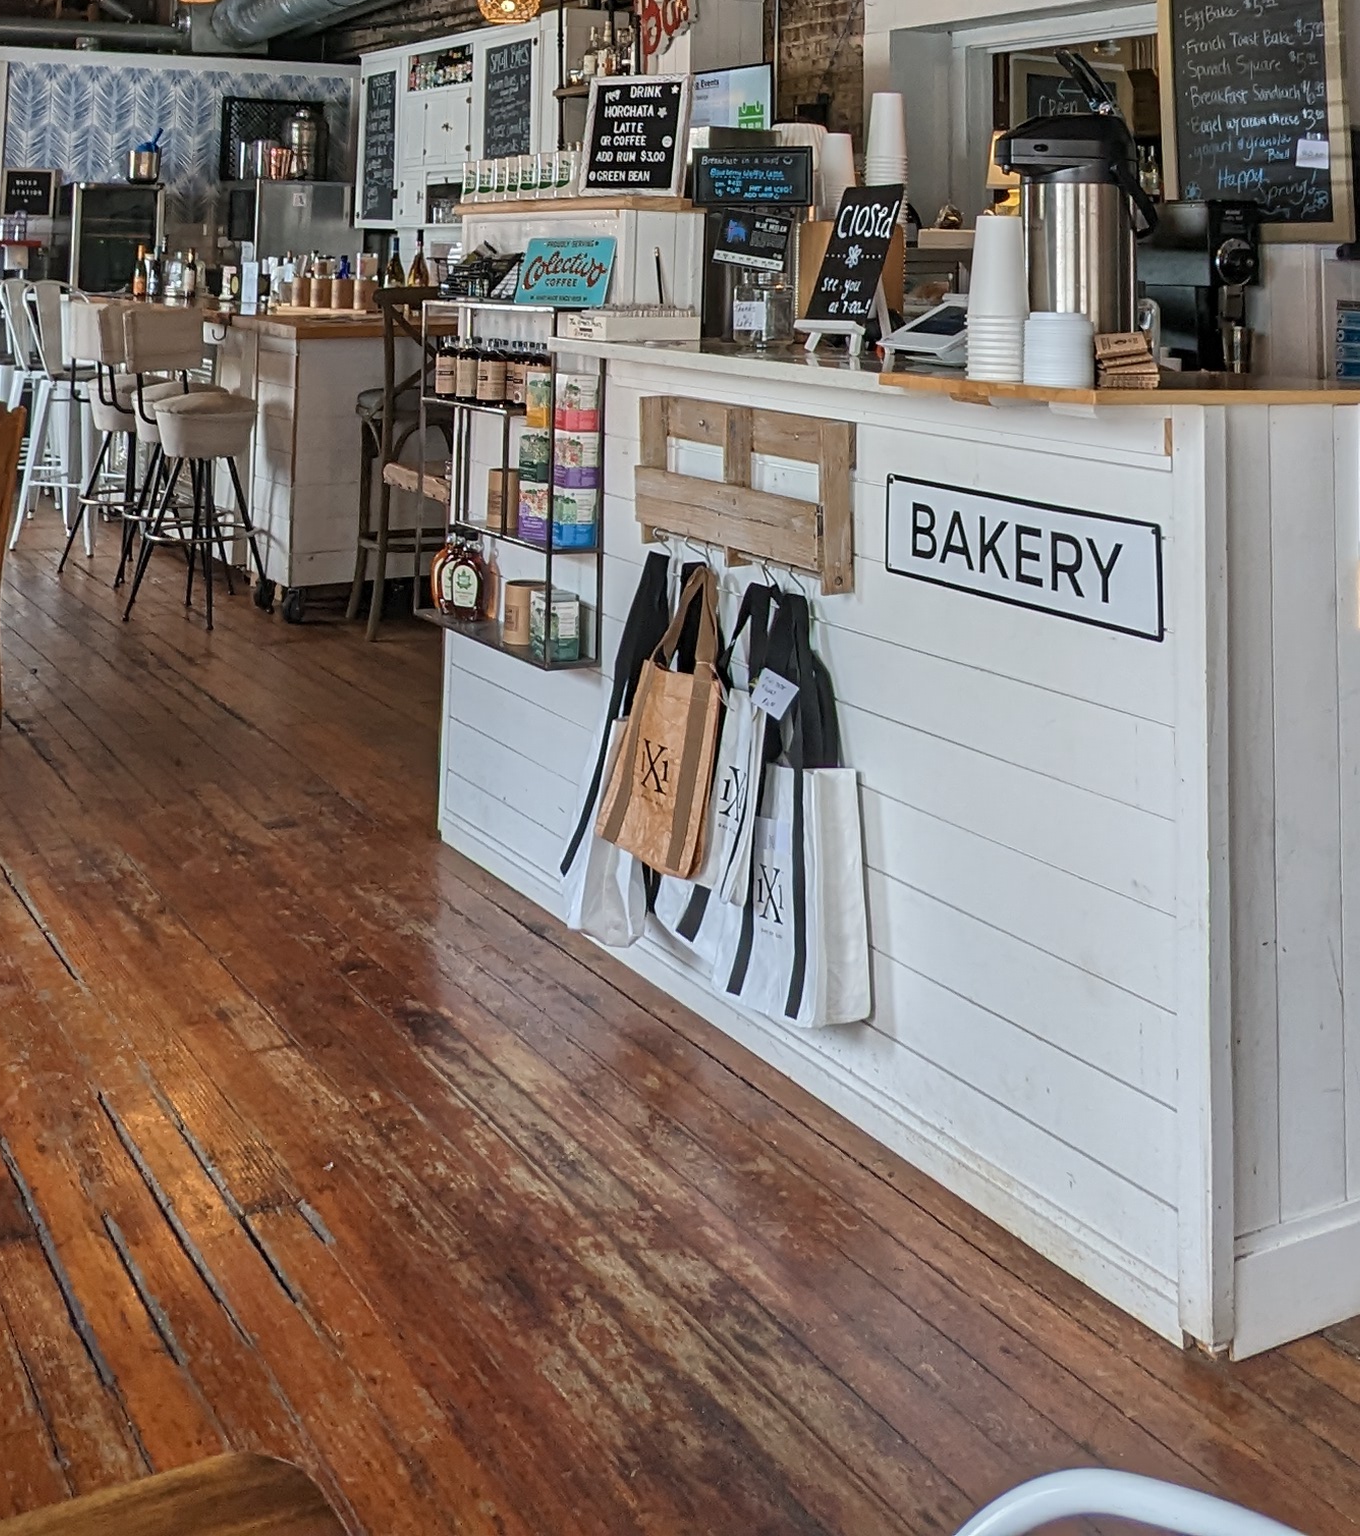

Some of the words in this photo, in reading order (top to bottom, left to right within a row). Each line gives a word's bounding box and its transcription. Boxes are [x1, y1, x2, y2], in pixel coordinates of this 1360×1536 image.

[1186, 35, 1226, 55] French
[1229, 31, 1259, 48] Toast
[1262, 28, 1295, 47] Bake
[630, 85, 663, 99] DRINK
[1190, 85, 1248, 108] Breakfast
[604, 105, 655, 118] HORCHATA
[613, 121, 644, 134] LATTE
[600, 135, 612, 146] OR
[612, 135, 647, 146] COFFEE
[595, 151, 614, 162] ADD
[616, 151, 637, 162] RUM
[640, 150, 666, 162] $3.00
[627, 170, 651, 182] BEAN
[1217, 165, 1268, 194] Happy
[522, 250, 608, 291] Colectivo
[544, 278, 578, 287] COFFEE
[841, 278, 862, 300] you
[911, 500, 1124, 606] BAKERY
